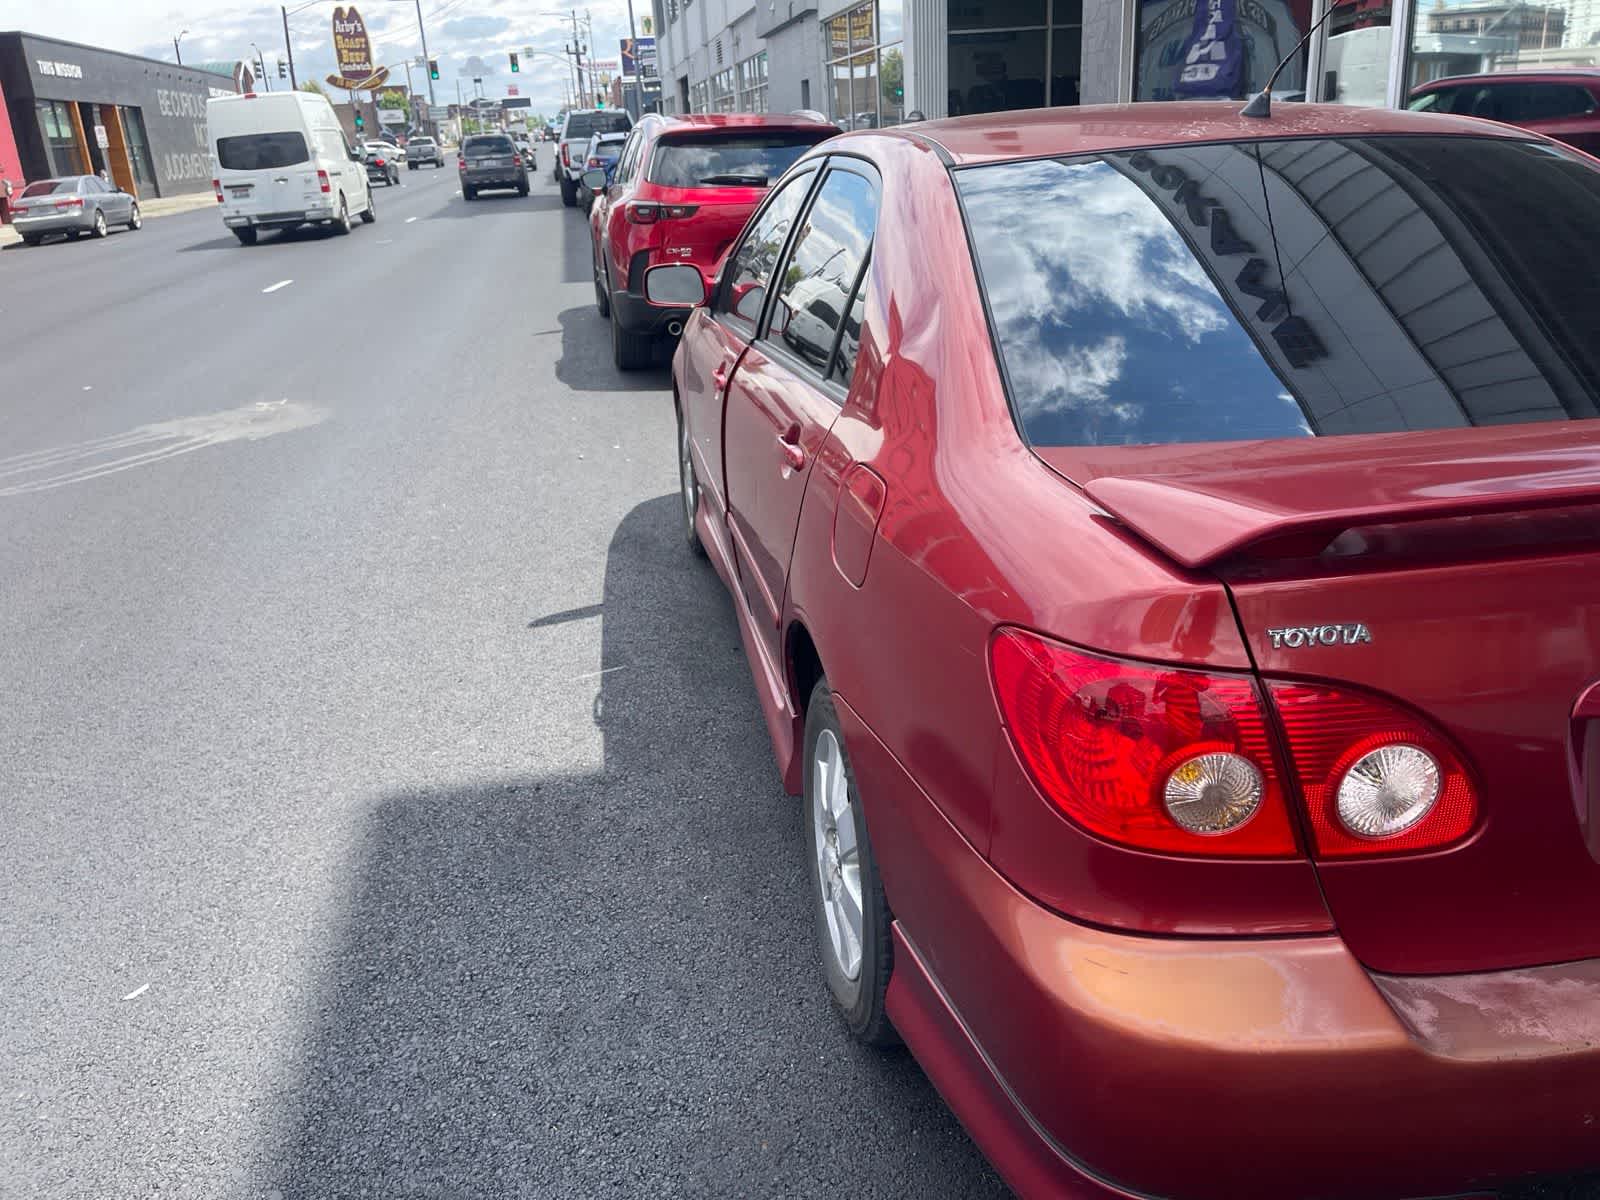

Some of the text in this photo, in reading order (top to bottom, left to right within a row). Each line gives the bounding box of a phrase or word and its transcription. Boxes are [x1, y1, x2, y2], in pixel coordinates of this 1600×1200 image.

[336, 20, 361, 35] Arby's
[54, 62, 82, 79] MISSION
[1267, 623, 1371, 648] TOYOTA
